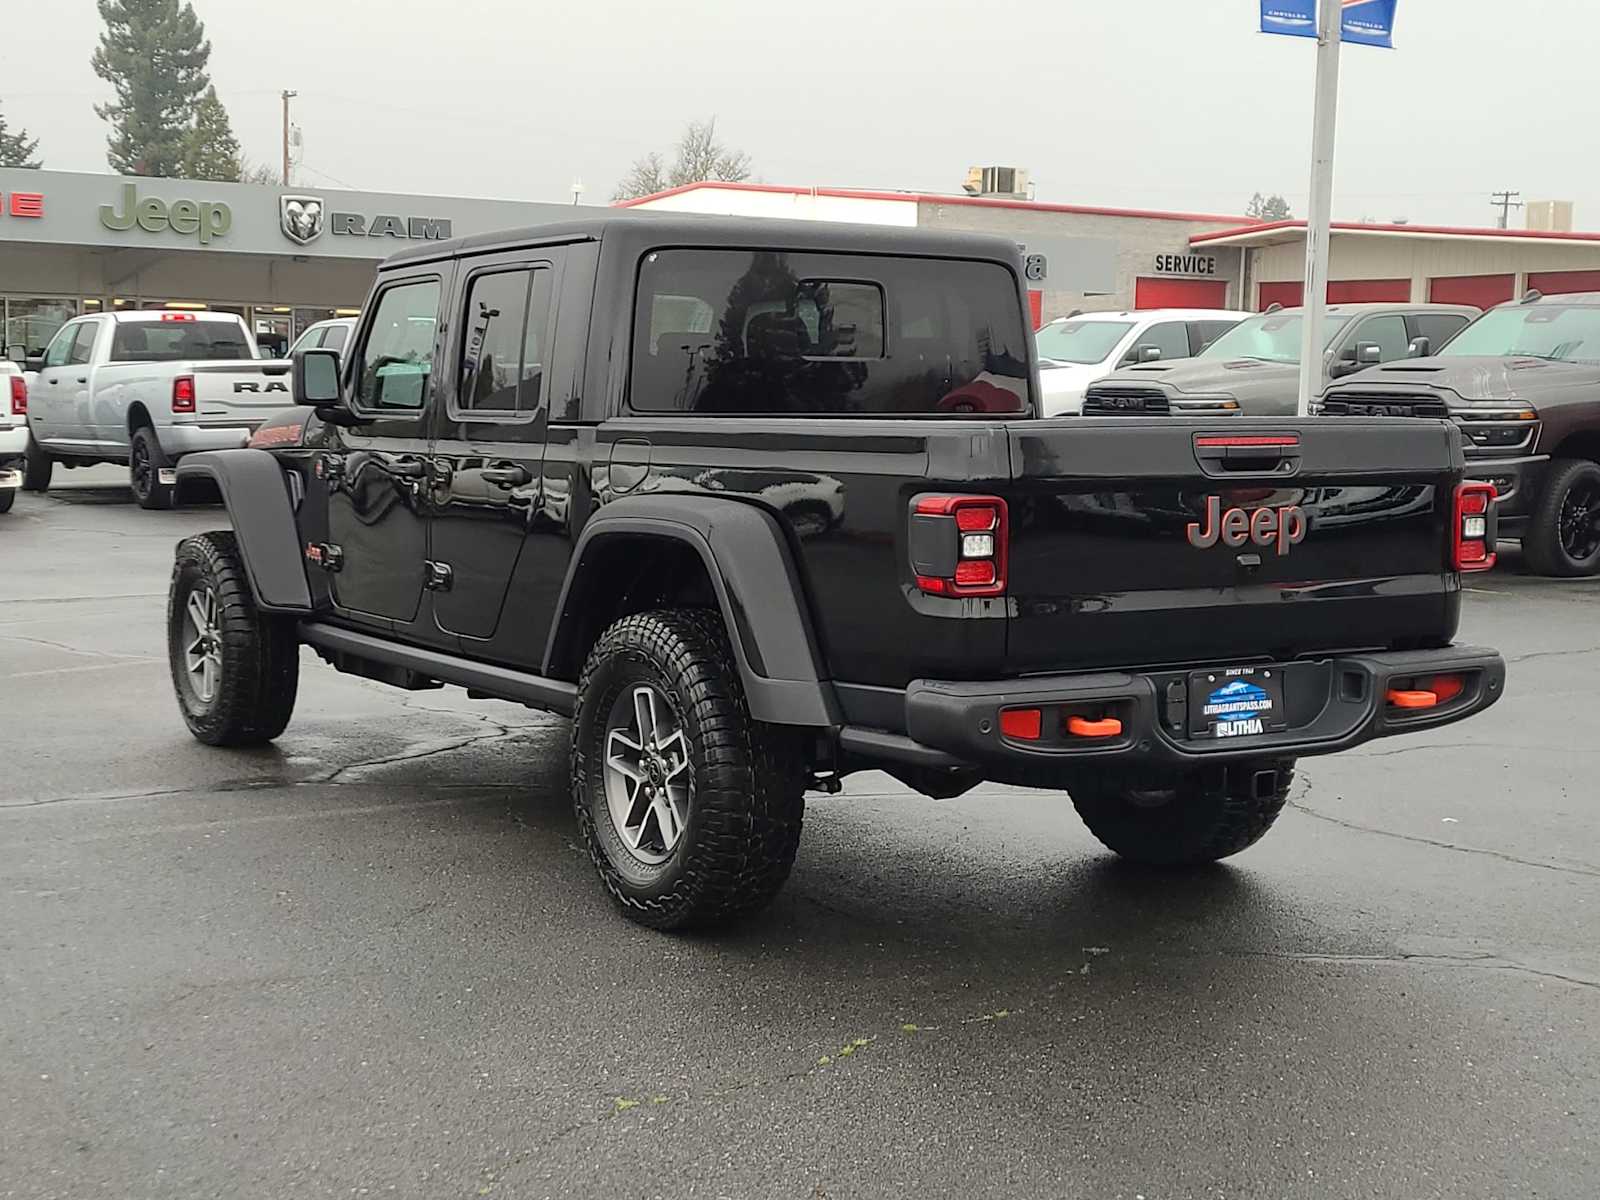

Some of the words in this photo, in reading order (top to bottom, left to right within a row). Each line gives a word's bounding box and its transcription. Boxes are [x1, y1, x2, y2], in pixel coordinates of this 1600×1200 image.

[99, 183, 232, 244] Jeep
[331, 211, 453, 240] RAM
[1155, 254, 1215, 274] SERVICE
[1187, 495, 1307, 556] Jeep
[1228, 719, 1264, 736] LITHIA
